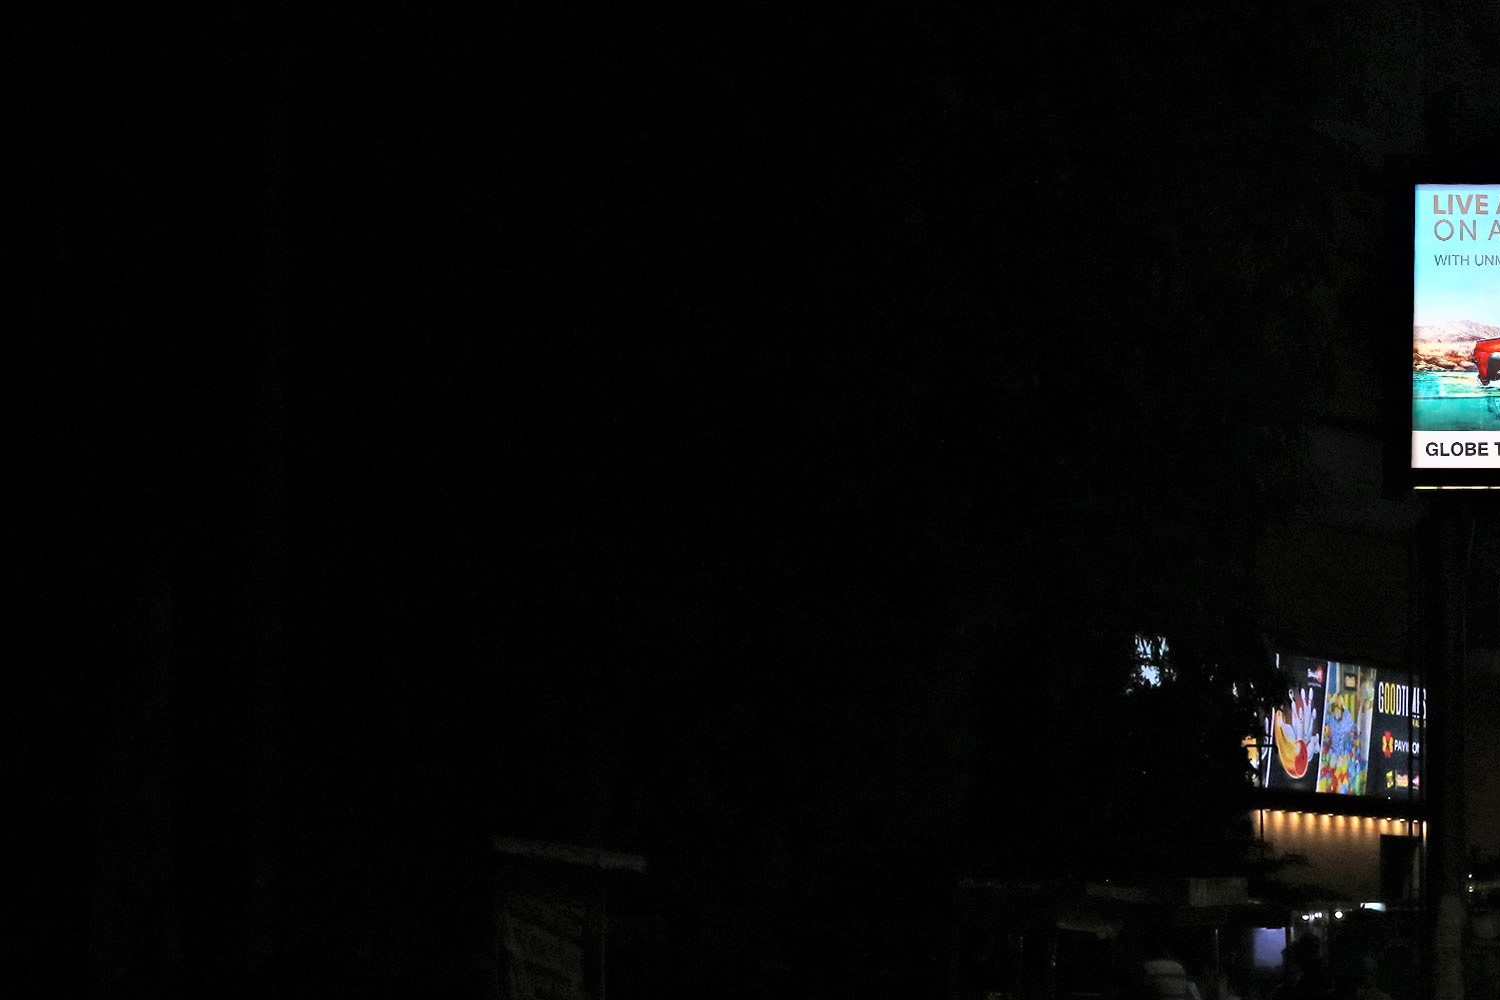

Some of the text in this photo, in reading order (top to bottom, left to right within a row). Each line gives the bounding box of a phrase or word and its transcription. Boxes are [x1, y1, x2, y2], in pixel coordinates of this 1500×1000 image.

[1433, 193, 1489, 215] LIVE
[1433, 218, 1477, 242] ON
[1434, 254, 1470, 267] WITH
[1425, 442, 1489, 457] GLOBE
